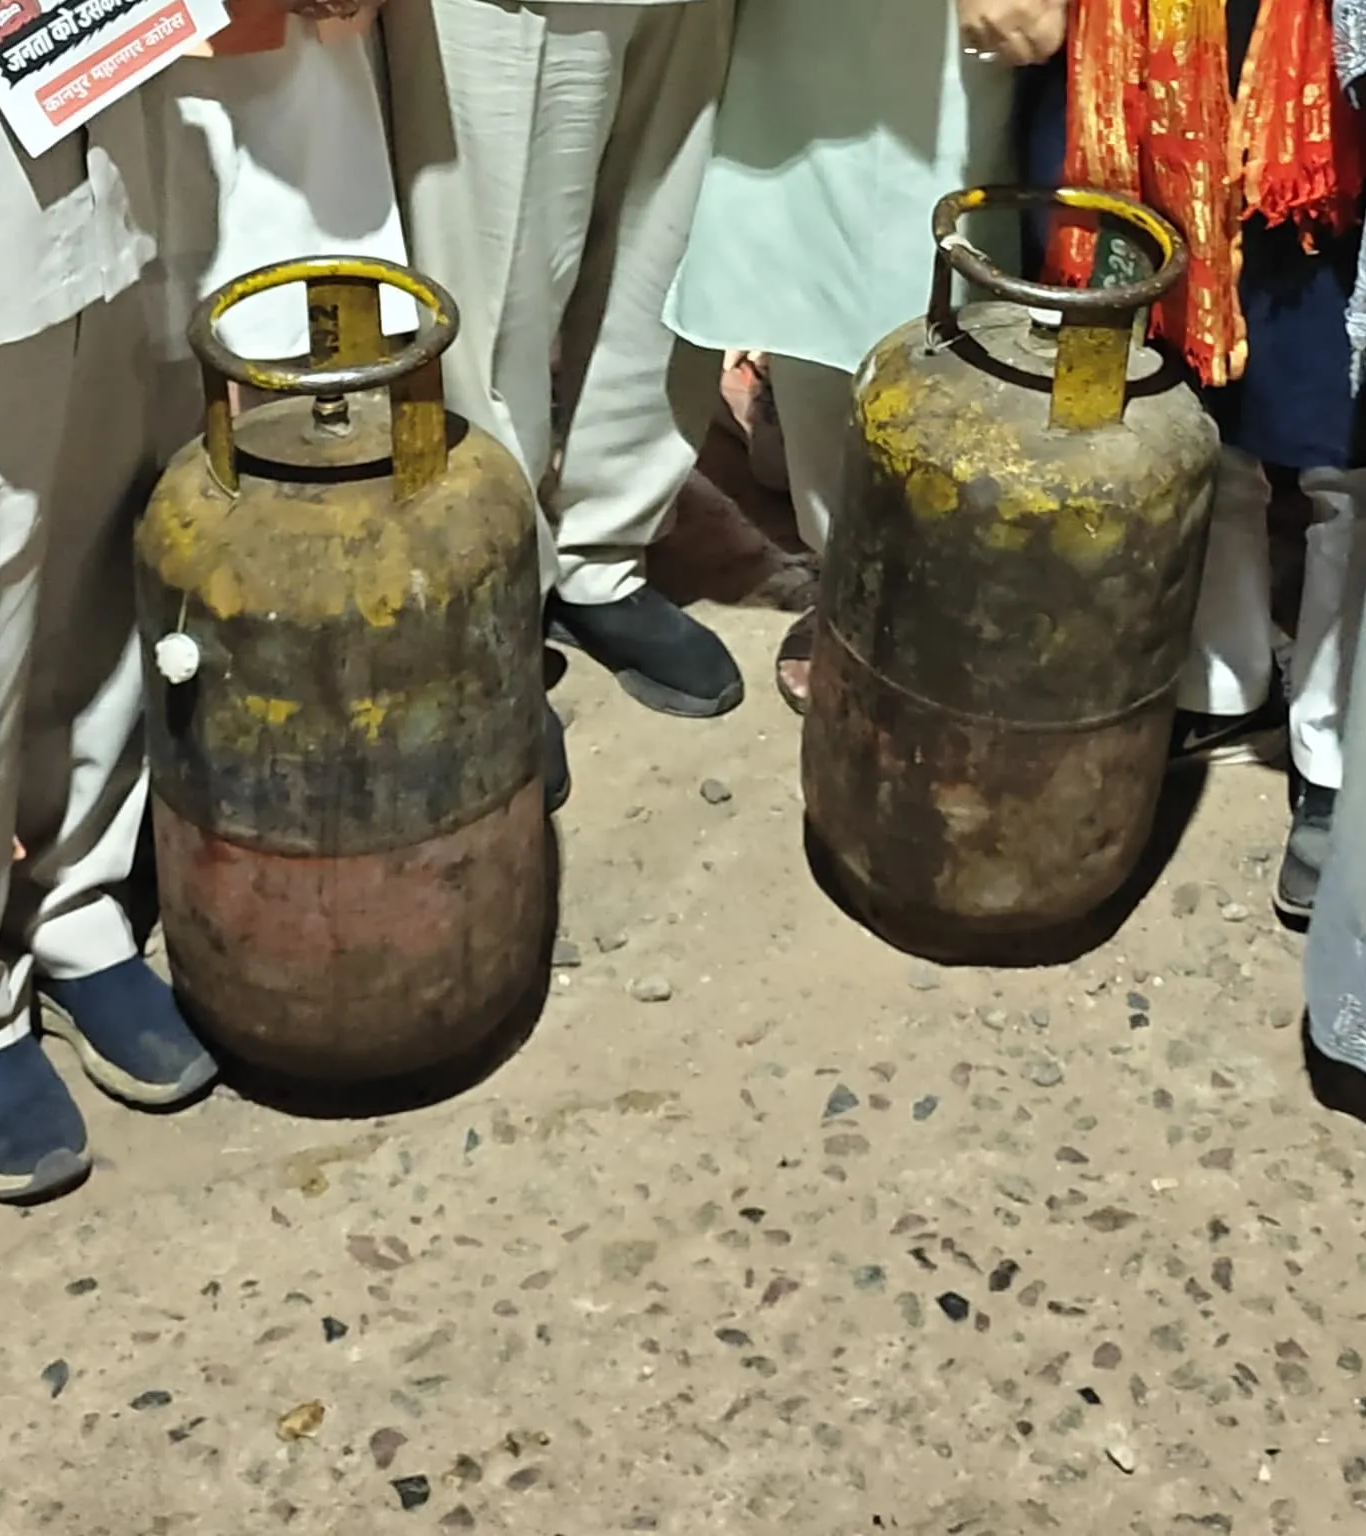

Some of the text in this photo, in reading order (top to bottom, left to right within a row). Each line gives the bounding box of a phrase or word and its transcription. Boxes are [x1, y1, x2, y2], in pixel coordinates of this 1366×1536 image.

[3, 26, 55, 72] जनता
[49, 8, 79, 41] को
[43, 74, 92, 112] कानपुर
[91, 38, 145, 80] महानगर
